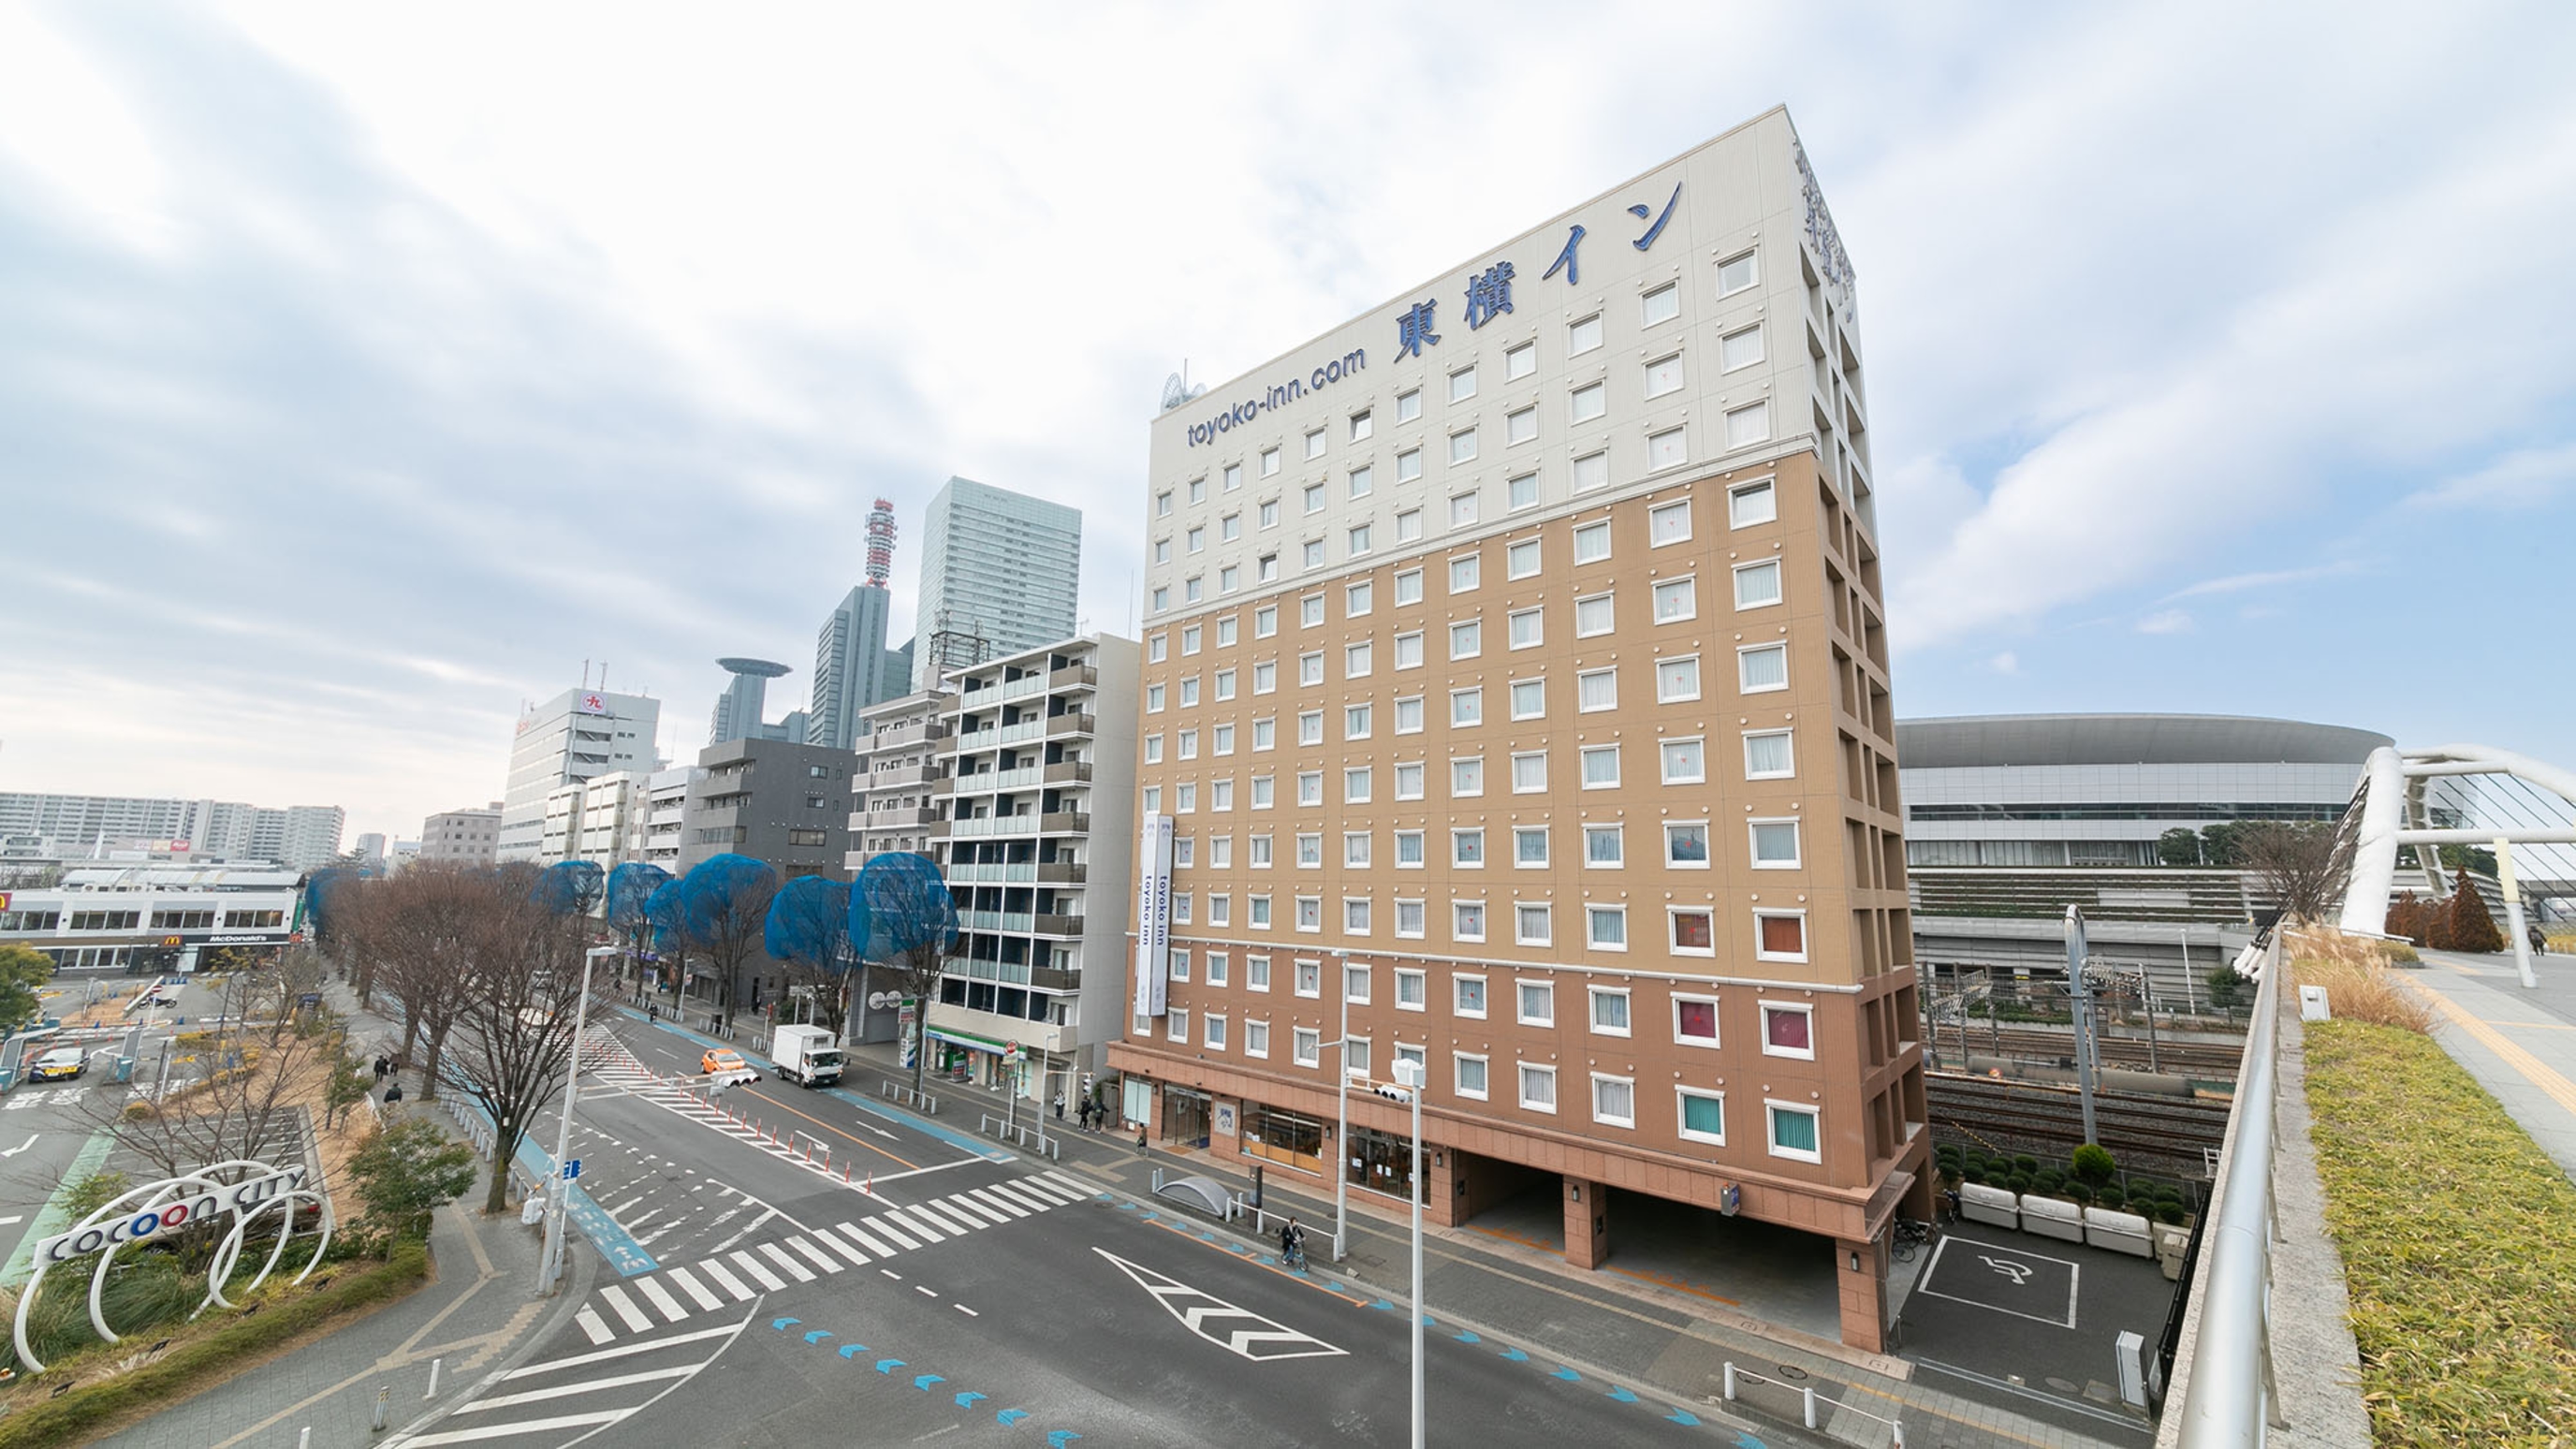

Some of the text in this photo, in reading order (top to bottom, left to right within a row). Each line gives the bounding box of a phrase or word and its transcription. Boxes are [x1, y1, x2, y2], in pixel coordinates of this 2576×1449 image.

[1393, 180, 1683, 363] 東横イン
[1187, 347, 1366, 446] toyoko-inn.com
[1144, 875, 1152, 920] toyoko
[1157, 875, 1167, 945] toyoko inn
[234, 1168, 305, 1206] CITY
